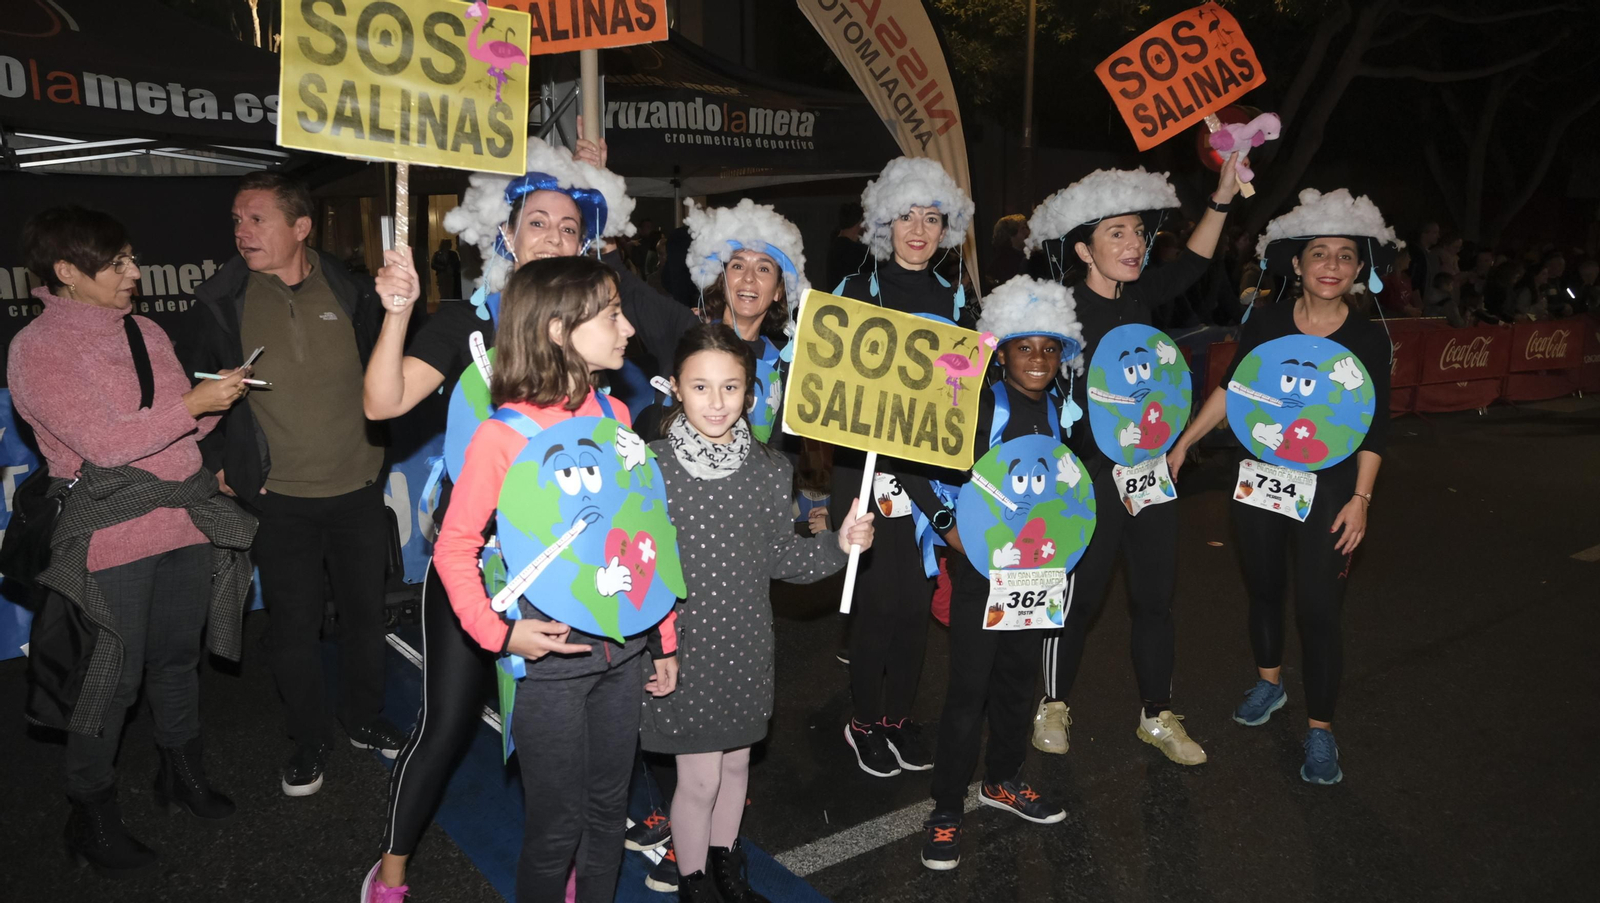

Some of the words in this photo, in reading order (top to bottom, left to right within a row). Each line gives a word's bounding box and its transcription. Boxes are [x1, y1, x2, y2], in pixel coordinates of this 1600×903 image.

[296, 0, 467, 86] SOS
[503, 0, 657, 43] ALINAS
[1108, 20, 1209, 100] SOS
[296, 72, 515, 159] SALINAS
[1132, 48, 1255, 138] SALINAS
[664, 132, 753, 148] cronometraje
[755, 134, 815, 150] deportivo
[805, 304, 941, 391] SOS
[796, 372, 966, 456] SALINAS
[1125, 470, 1157, 494] 828
[1255, 473, 1297, 498] 734
[1006, 590, 1047, 609] 362
